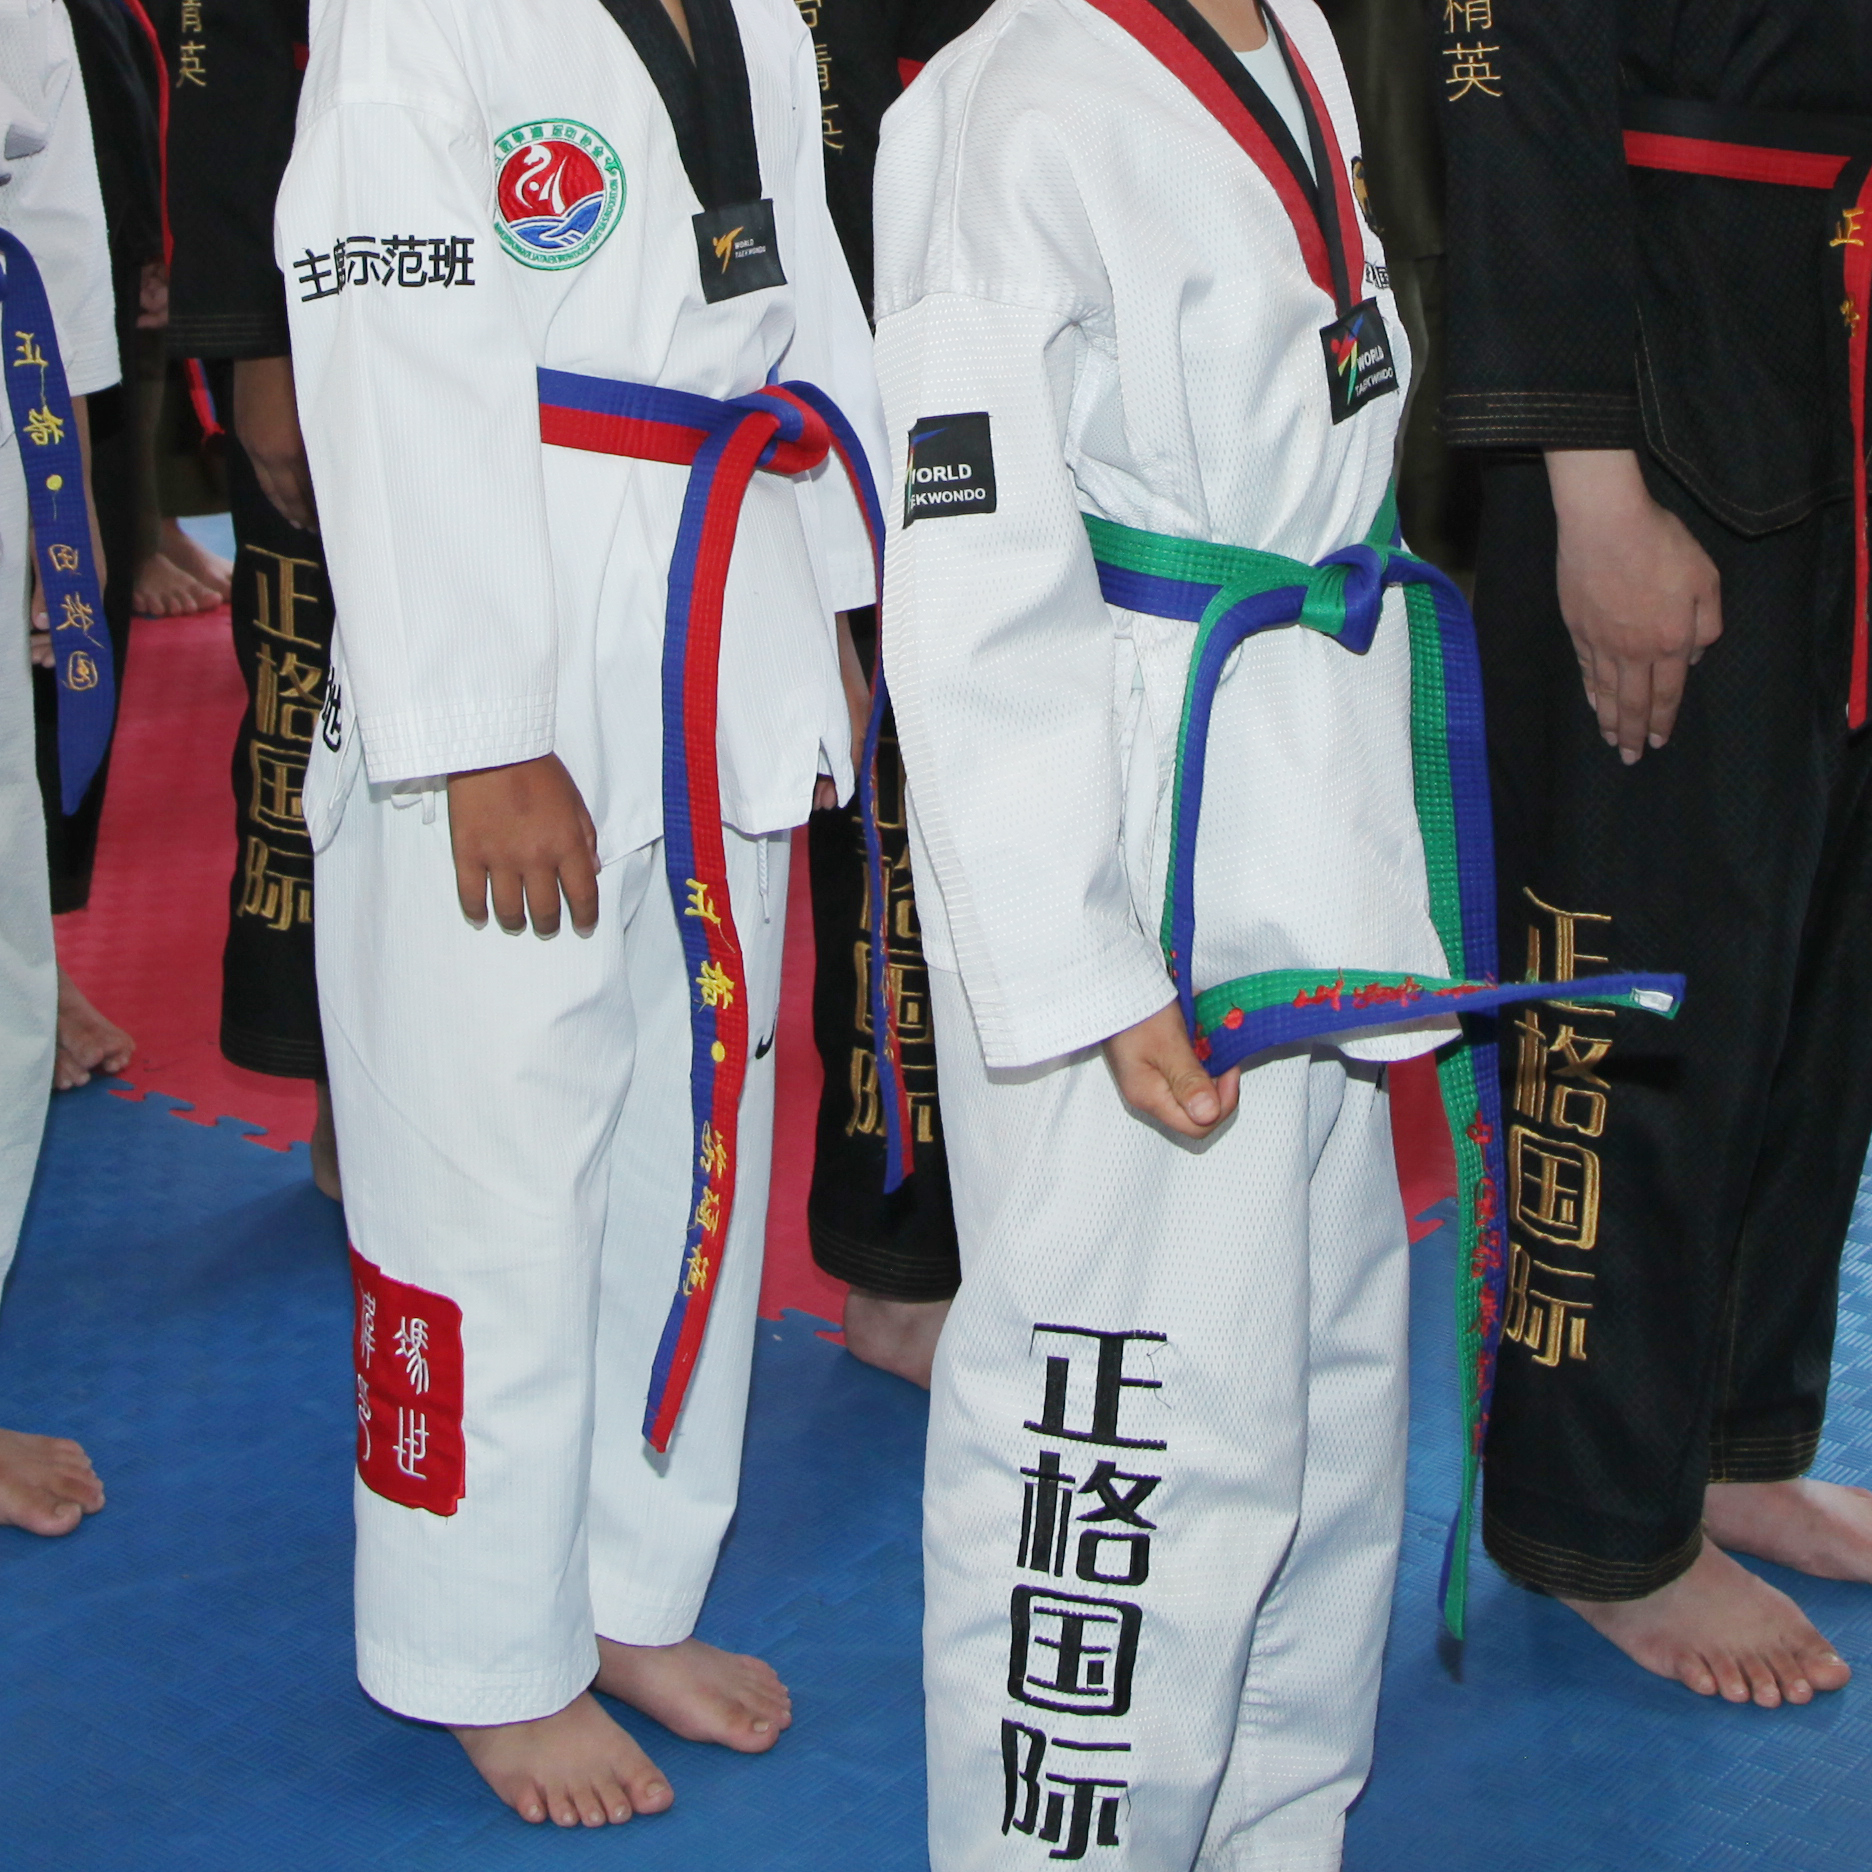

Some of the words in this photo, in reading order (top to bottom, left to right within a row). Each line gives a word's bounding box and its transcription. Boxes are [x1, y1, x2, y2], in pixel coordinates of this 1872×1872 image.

[1356, 344, 1385, 373] WORLD
[1000, 1322, 1169, 1861] 正格国际
